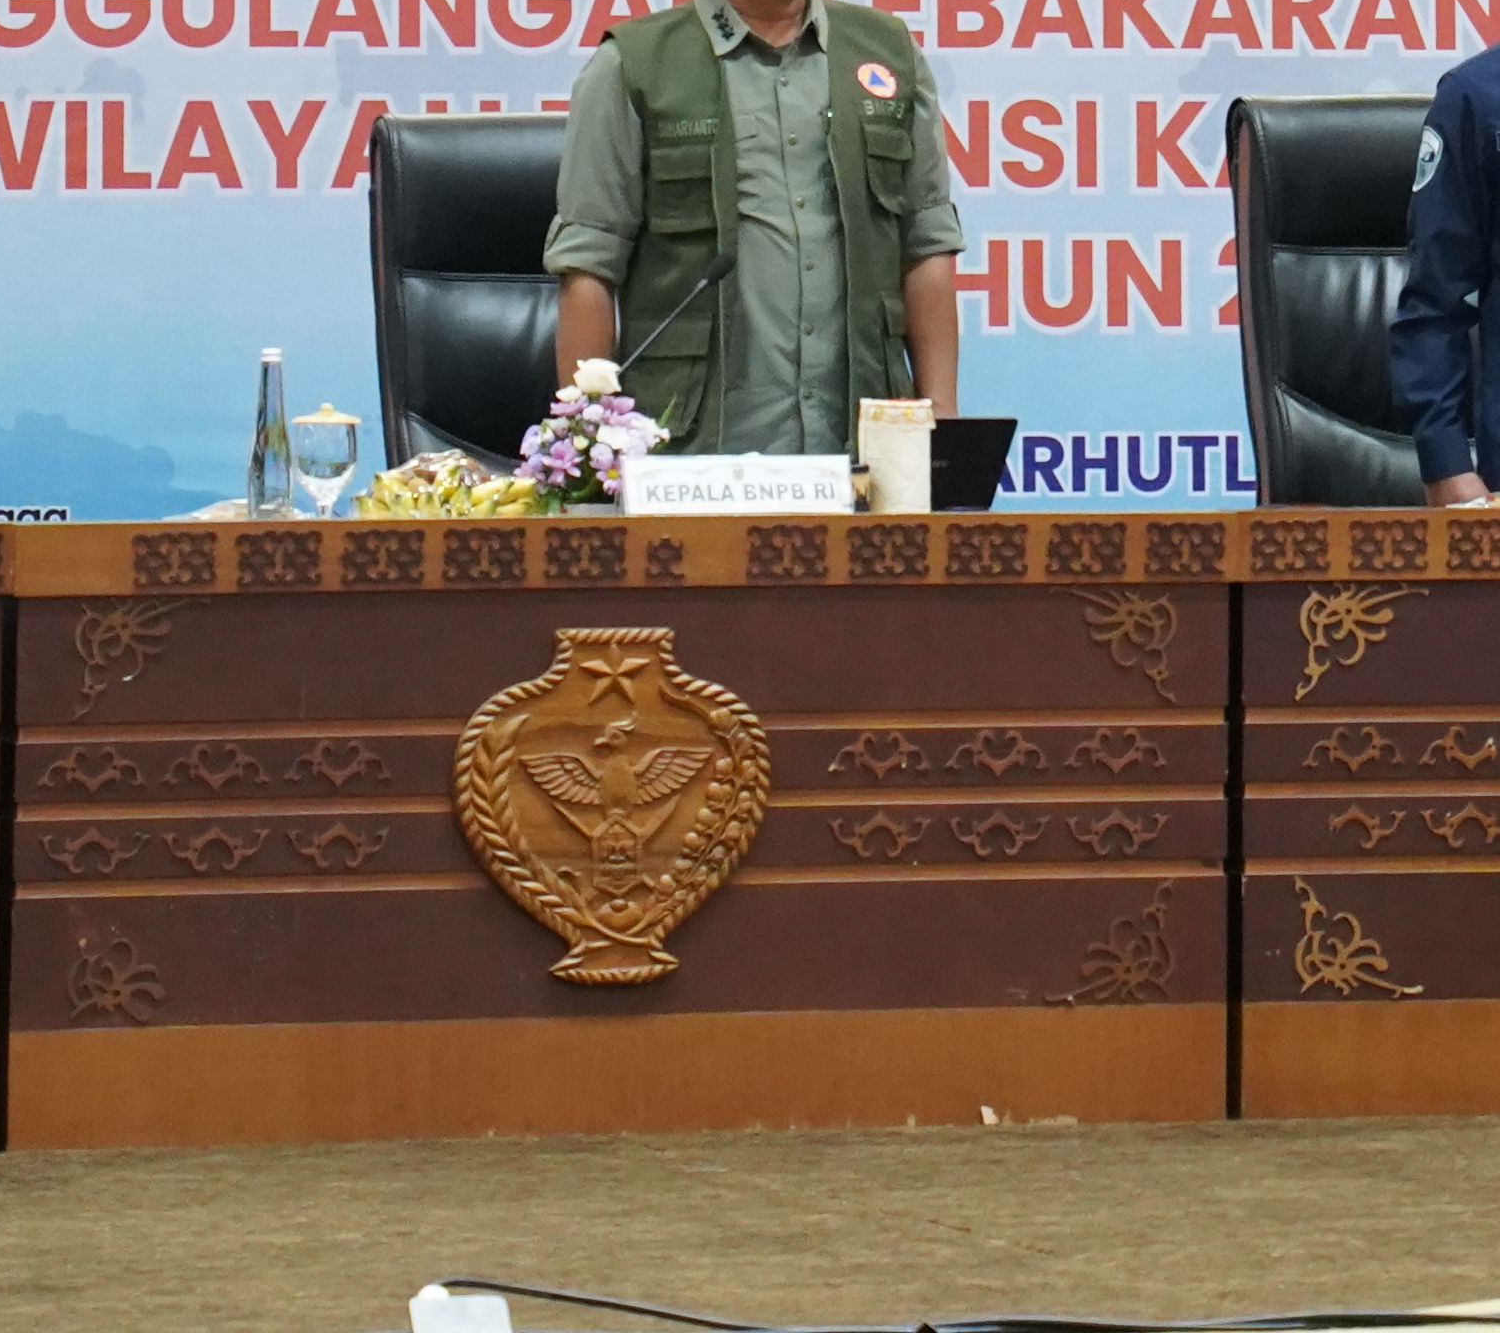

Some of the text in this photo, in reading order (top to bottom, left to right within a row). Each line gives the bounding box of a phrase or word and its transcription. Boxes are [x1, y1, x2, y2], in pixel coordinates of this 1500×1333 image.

[645, 482, 836, 503] KEPALA BNPB RI
